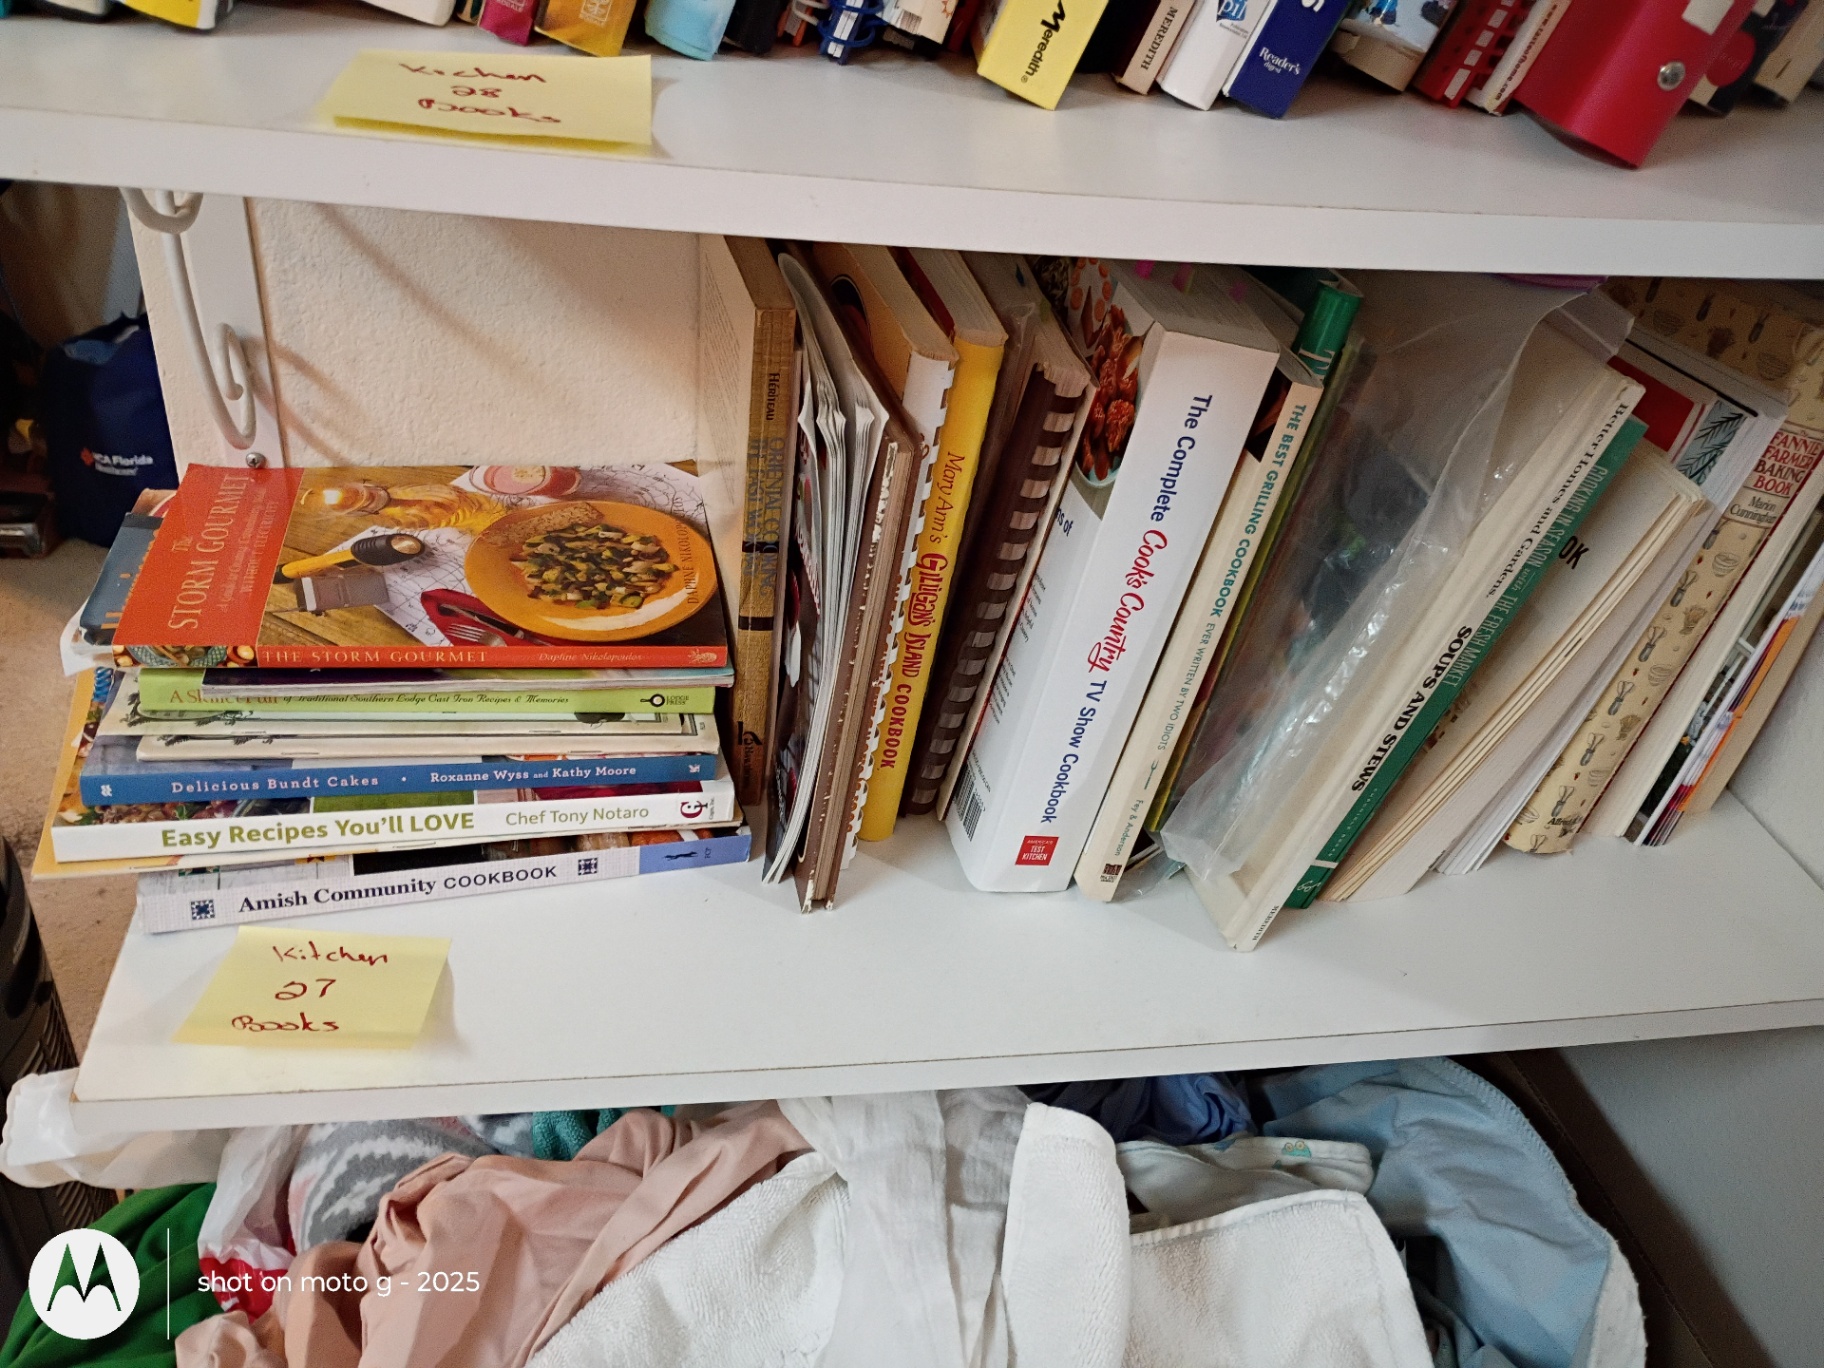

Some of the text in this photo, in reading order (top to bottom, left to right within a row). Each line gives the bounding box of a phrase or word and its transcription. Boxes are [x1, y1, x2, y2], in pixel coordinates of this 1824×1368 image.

[1141, 6, 1178, 70] MEREDITH
[1259, 47, 1300, 75] Reader's
[1591, 403, 1629, 450] Better
[1770, 431, 1821, 456] FANNIE
[763, 437, 785, 511] ORIENTAL
[936, 451, 965, 498] Mary
[1753, 459, 1805, 483] BAKING
[1761, 445, 1814, 469] FARMER
[1552, 453, 1595, 504] Homes
[1753, 475, 1794, 495] BOOK
[930, 497, 954, 544] Ann's
[1530, 507, 1553, 535] and
[168, 474, 249, 629] STORM GOURMET
[682, 566, 699, 604] DAPHNE
[1157, 404, 1306, 750] THE BEST GRILLING COOKBOOK EVER WRITTEN BY TWO IDIOTS
[1040, 395, 1212, 824] The Complete Cook's Country TV Show Cookbook
[262, 650, 301, 663] THE
[312, 651, 380, 663] STORM
[390, 650, 488, 663] GOURMET
[539, 653, 577, 663] Daphne
[901, 632, 931, 678] ISLAND
[1442, 646, 1482, 688] MARKET
[349, 693, 394, 703] Southern
[395, 693, 425, 705] Lodge
[427, 693, 450, 703] Cast
[453, 693, 475, 704] Iron
[476, 693, 511, 705] Recipes
[526, 694, 569, 704] Memories
[1352, 625, 1472, 792] SOUPS AND STEWS
[880, 684, 912, 769] COOKBOOK
[171, 764, 637, 794] Delicious Bundt Cakes Roxanne Wyss and Kathy Moore
[1131, 799, 1144, 813] Fey
[161, 806, 649, 849] Easy Recipes You'll LOVE Chef Tony Notaro
[1114, 821, 1134, 856] Anderson
[1021, 853, 1048, 861] KITCHEN
[1030, 845, 1046, 853] TEST
[238, 865, 558, 913] Amish Community COOKBOOK
[272, 941, 388, 965] Kitchen
[275, 978, 336, 1000] 27
[231, 1012, 339, 1032] Books
